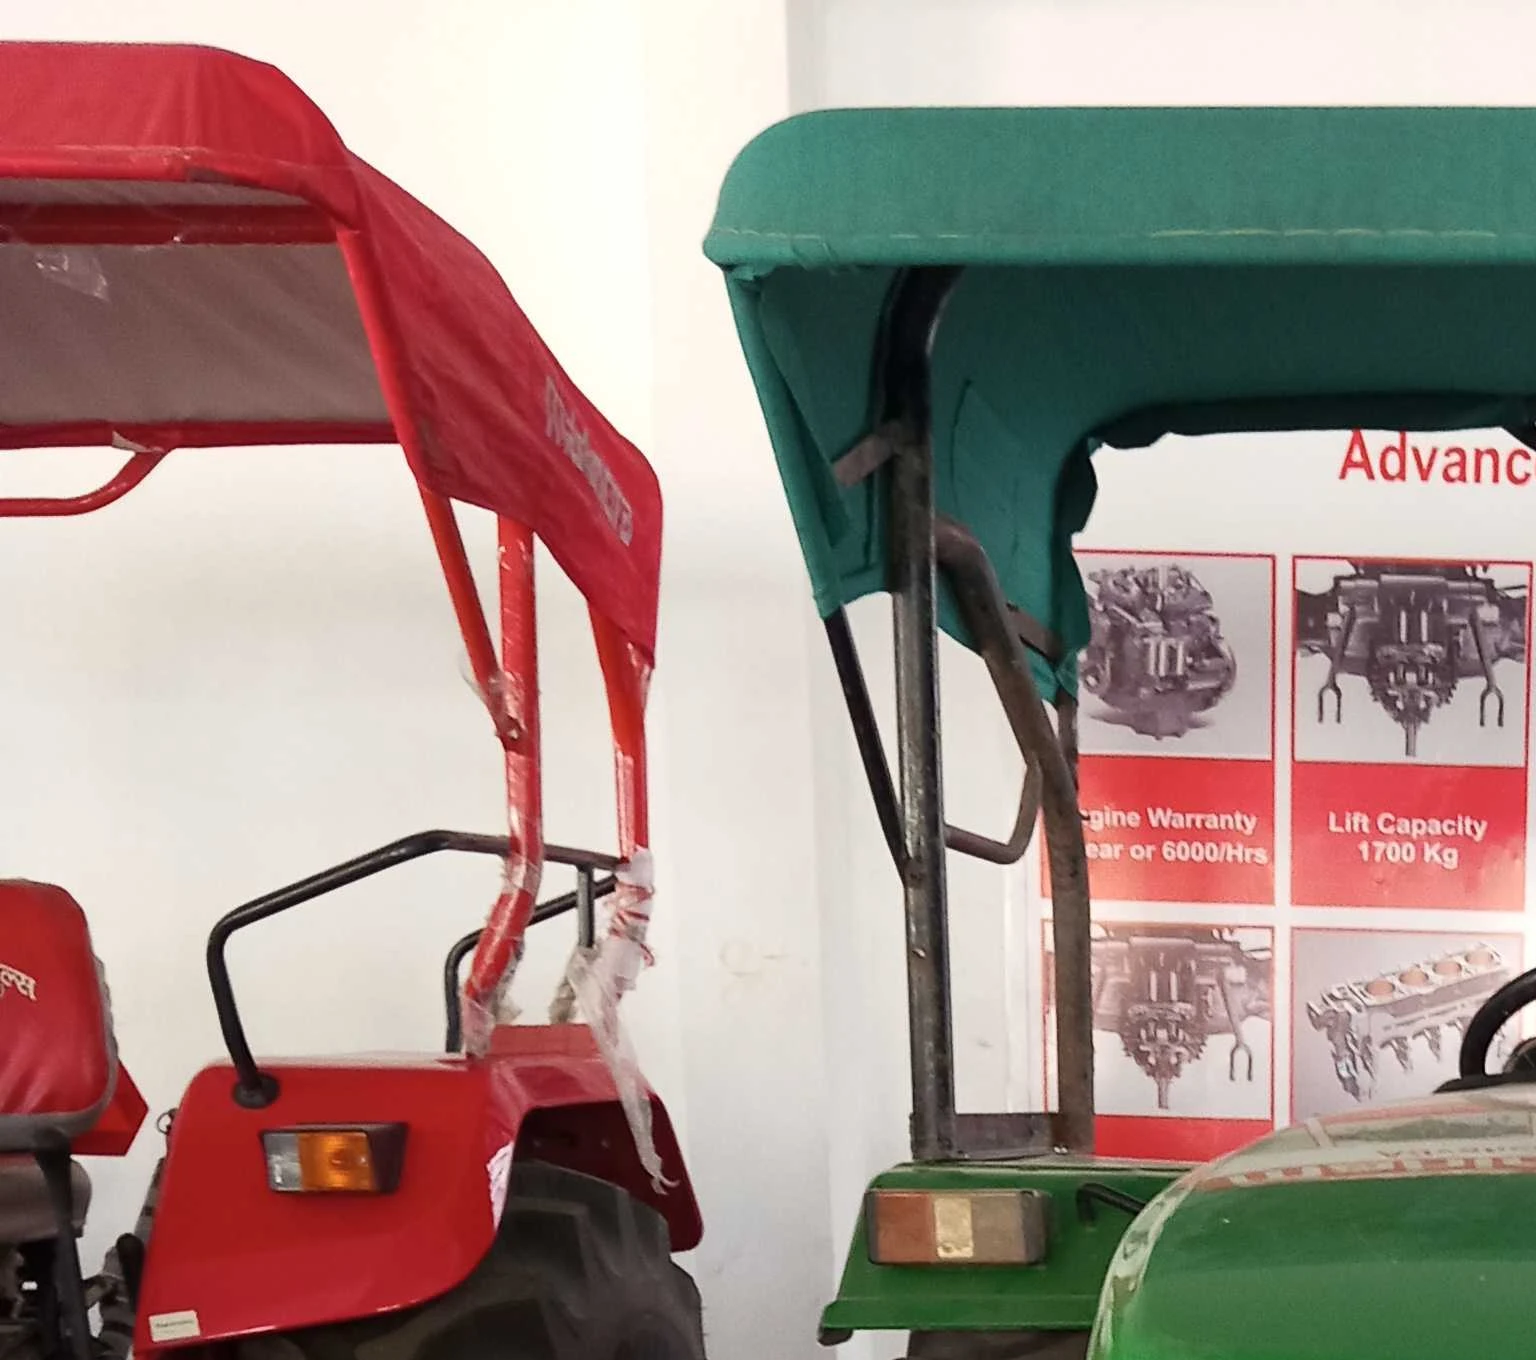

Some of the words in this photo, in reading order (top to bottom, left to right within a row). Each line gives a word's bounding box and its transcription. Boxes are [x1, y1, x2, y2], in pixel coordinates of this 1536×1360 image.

[1147, 807, 1257, 836] Warranty
[1328, 811, 1370, 834] Lift
[1376, 812, 1487, 842] Capacity
[1085, 841, 1123, 860] ear
[1130, 844, 1155, 861] or
[1162, 840, 1268, 864] 6000/Hrs
[1358, 840, 1415, 864] 1700
[1423, 841, 1458, 870] Kg
